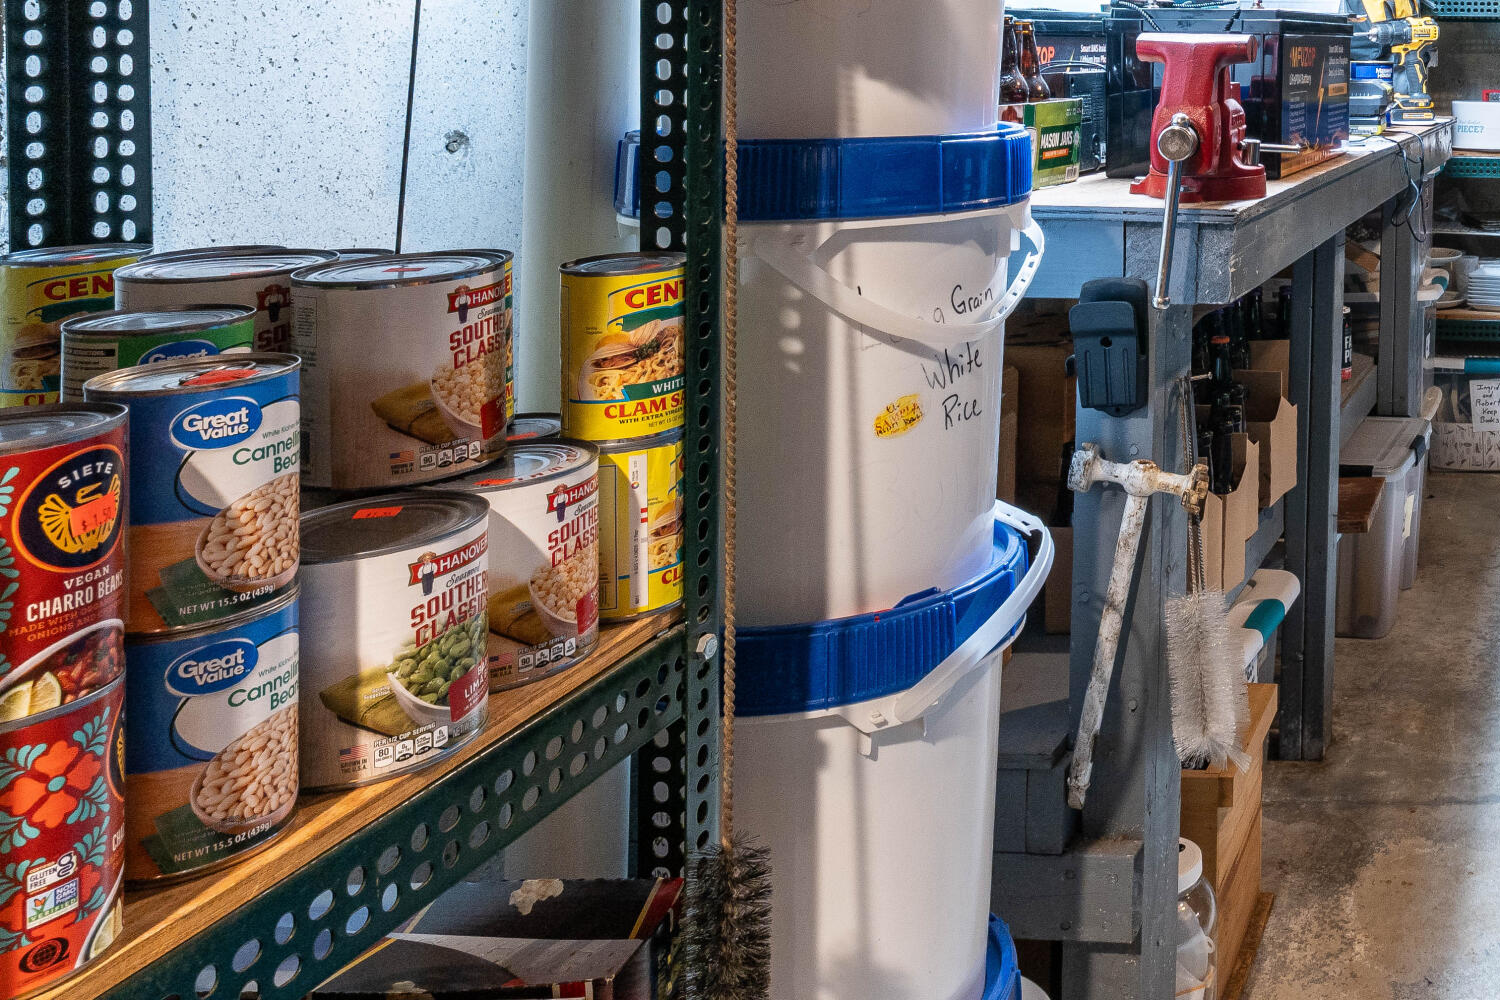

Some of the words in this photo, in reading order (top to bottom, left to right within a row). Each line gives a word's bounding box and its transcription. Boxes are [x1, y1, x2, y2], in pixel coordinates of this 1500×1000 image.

[1037, 46, 1055, 64] ZOP
[1040, 133, 1059, 149] MASON
[1457, 125, 1485, 134] PIECE?
[44, 273, 114, 300] CEN
[472, 285, 504, 304] HANO
[624, 279, 686, 309] CENT
[951, 284, 993, 315] Grain
[449, 312, 505, 352] SOUTHE
[453, 333, 505, 369] CLASS
[921, 342, 982, 390] White
[182, 407, 249, 432] Great
[604, 398, 667, 420] CLAM
[619, 417, 639, 425] WITH
[641, 412, 664, 422] EXTRA
[942, 393, 983, 430] Rice
[200, 423, 249, 441] Value
[232, 431, 300, 466] Cannelli
[58, 461, 113, 489] SIETE
[570, 481, 598, 502] HANO
[547, 504, 599, 551] SOUTHE
[551, 526, 599, 568] CLASSI
[64, 564, 110, 590] VEGAN
[26, 586, 94, 622] CHARRO
[97, 569, 124, 600] BEANS
[178, 604, 198, 616] NET
[200, 600, 216, 612] WT
[218, 597, 238, 608] 15.5
[239, 591, 251, 601] OZ
[410, 570, 488, 628] SOUTHER
[8, 621, 45, 638] MADE
[50, 612, 78, 626] WITH
[415, 590, 488, 648] CLASSIC
[27, 623, 74, 642] ONIONS
[177, 647, 245, 679] Great
[521, 657, 530, 666] 90
[195, 664, 245, 686] Value
[228, 661, 299, 708] Cannelli
[399, 730, 412, 740] CUP
[412, 721, 436, 737] SERVING
[378, 747, 389, 758] 80
[174, 850, 192, 863] NET
[195, 845, 211, 858] WT
[213, 837, 233, 852] 15.5
[234, 831, 247, 843] OZ
[29, 867, 58, 882] GLUTEN
[29, 878, 47, 890] FREE
[55, 880, 77, 894] NON
[56, 886, 77, 901] GMO
[28, 898, 78, 923] VERIFIED
